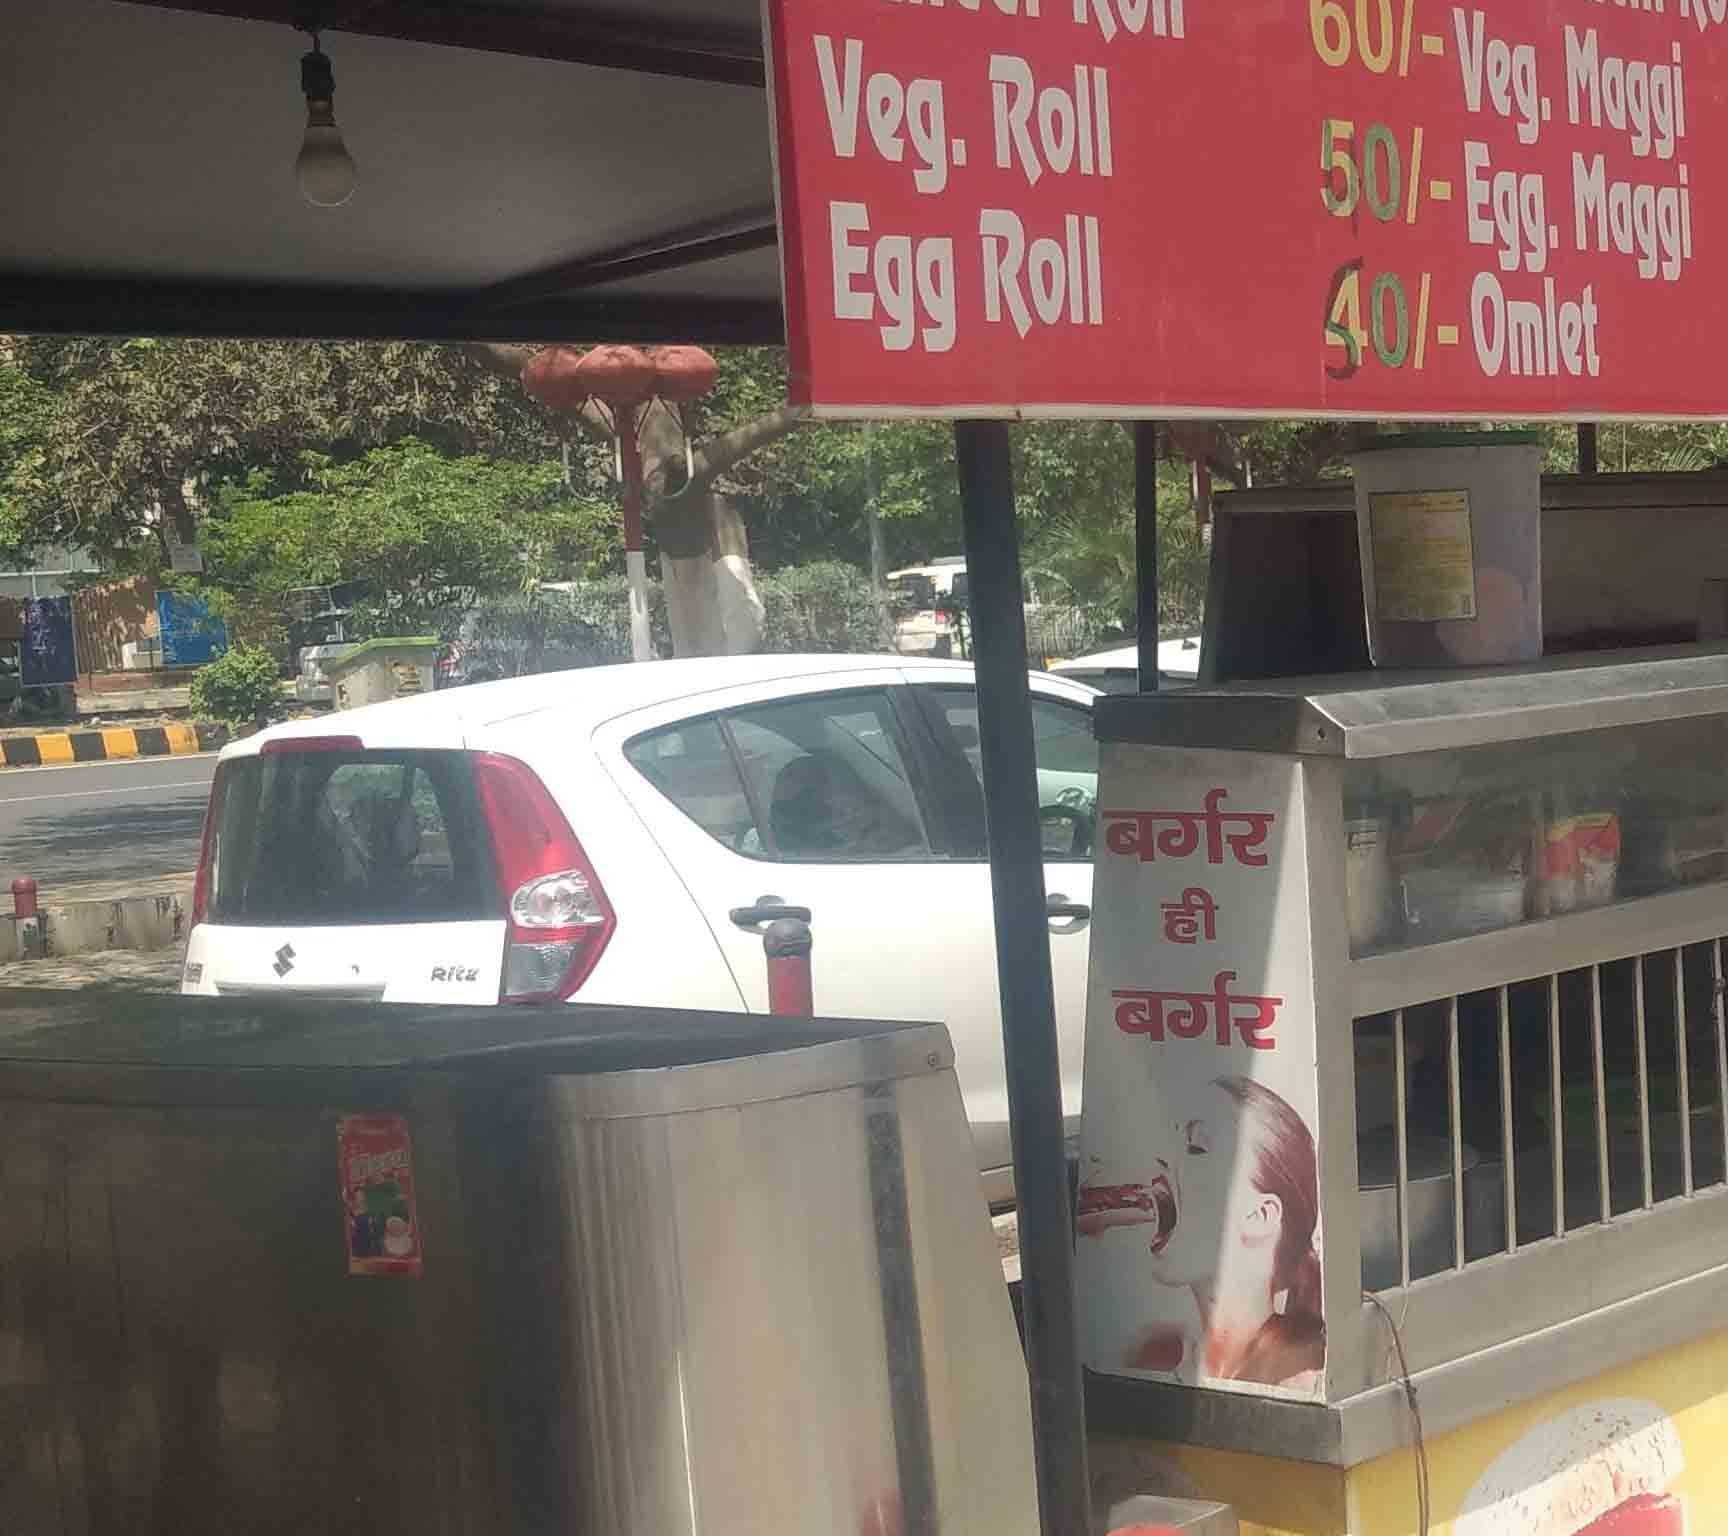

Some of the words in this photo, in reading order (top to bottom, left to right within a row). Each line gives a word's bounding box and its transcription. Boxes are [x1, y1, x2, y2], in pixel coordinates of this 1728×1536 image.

[815, 34, 967, 194] Veg.
[989, 54, 1114, 187] Roll
[1320, 119, 1452, 226] 50/-
[1452, 7, 1551, 145] Veg.
[1564, 25, 1685, 161] Maggi
[1464, 140, 1559, 273] Egg.
[1572, 151, 1692, 281] Maggi
[830, 201, 956, 353] Egg
[979, 208, 1104, 340] Roll
[1471, 271, 1600, 377] Omlet
[1103, 788, 1275, 867] बर्गर
[1160, 888, 1218, 945] ही
[1112, 970, 1285, 1051] बर्गर
